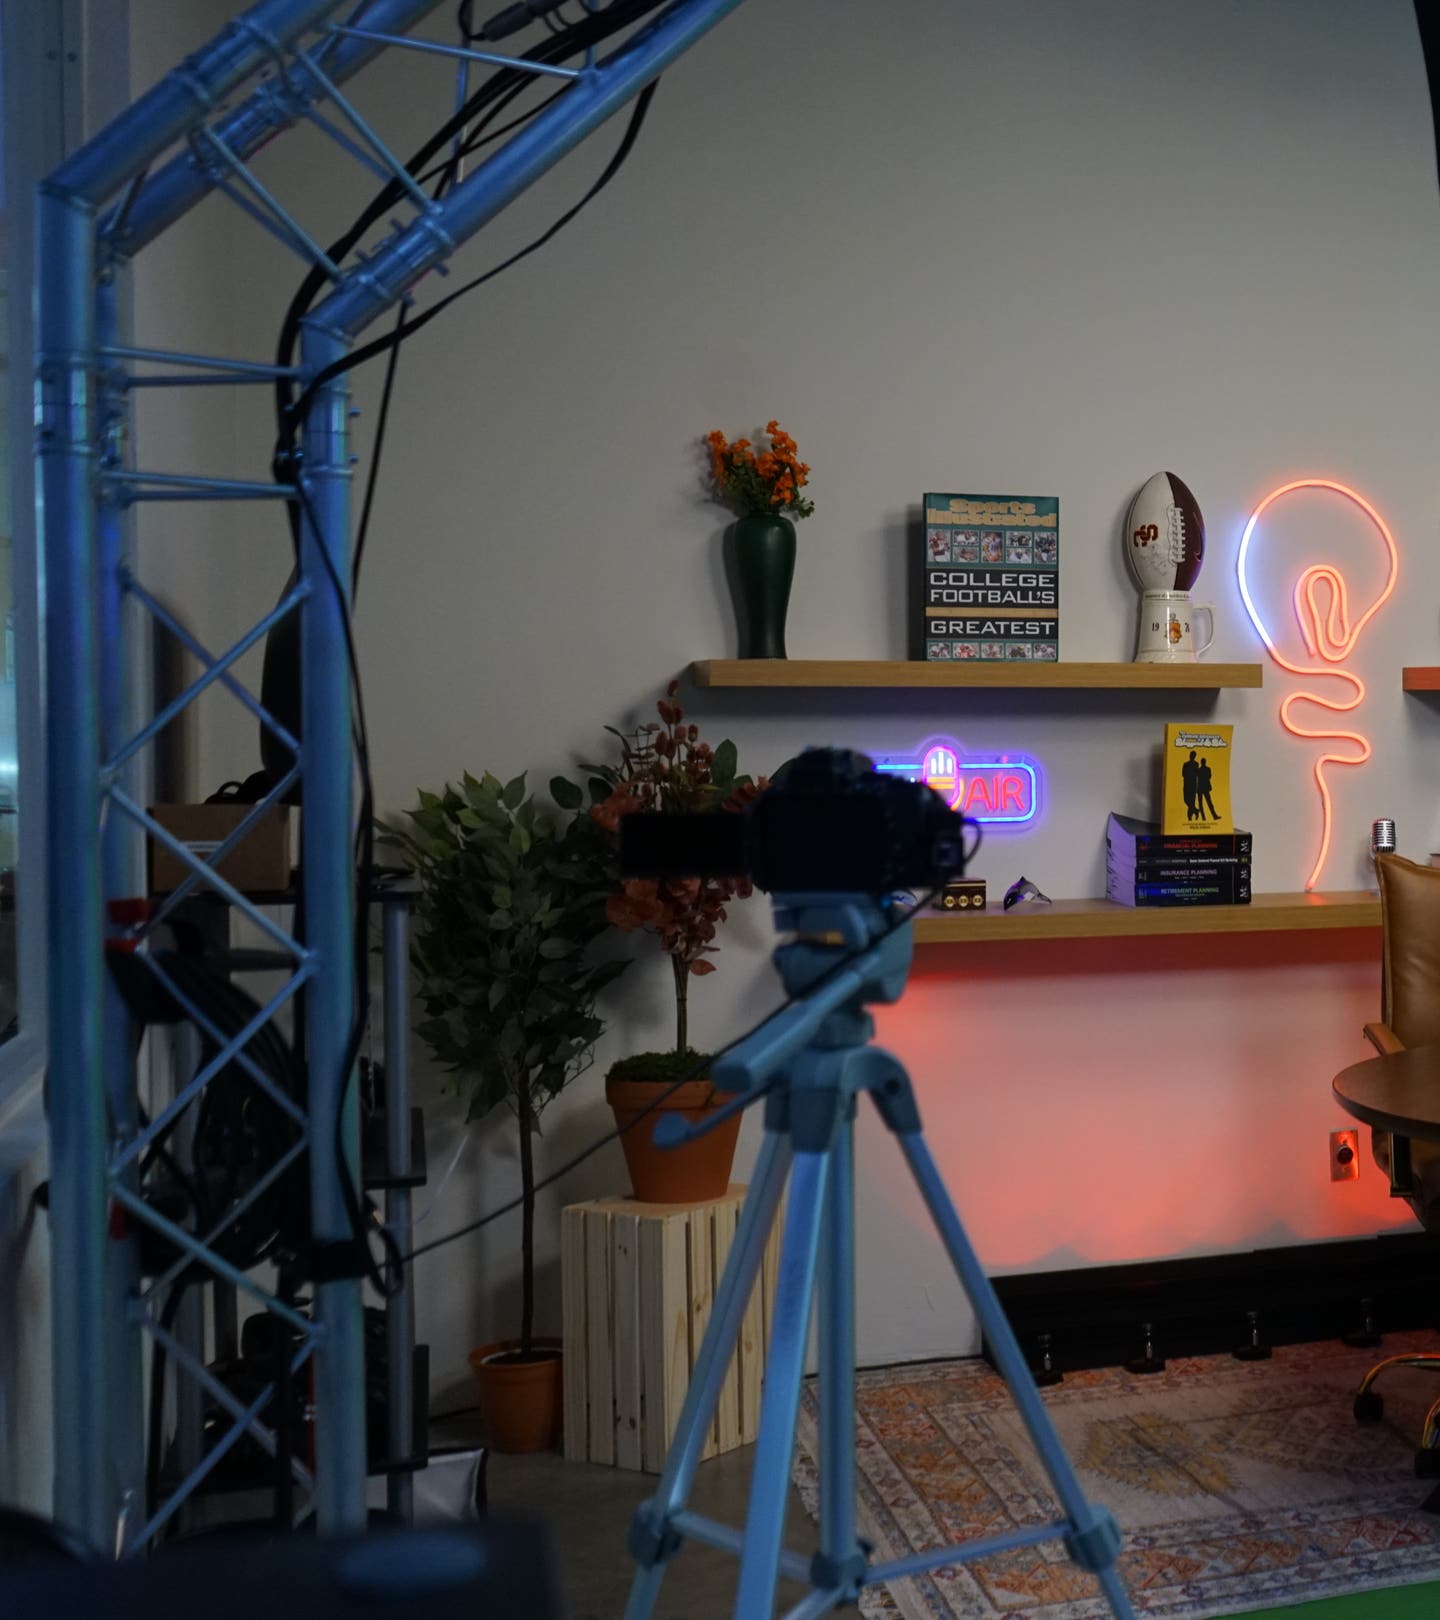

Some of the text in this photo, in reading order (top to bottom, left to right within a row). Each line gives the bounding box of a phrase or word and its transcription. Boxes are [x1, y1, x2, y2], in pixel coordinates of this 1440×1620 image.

[949, 498, 1037, 515] Sports
[927, 508, 1057, 528] Illustrated
[930, 572, 1055, 587] COLLEGE
[930, 589, 1055, 604] FOOTBALL'S
[930, 620, 1056, 635] GREATEST
[964, 777, 1024, 811] AIR
